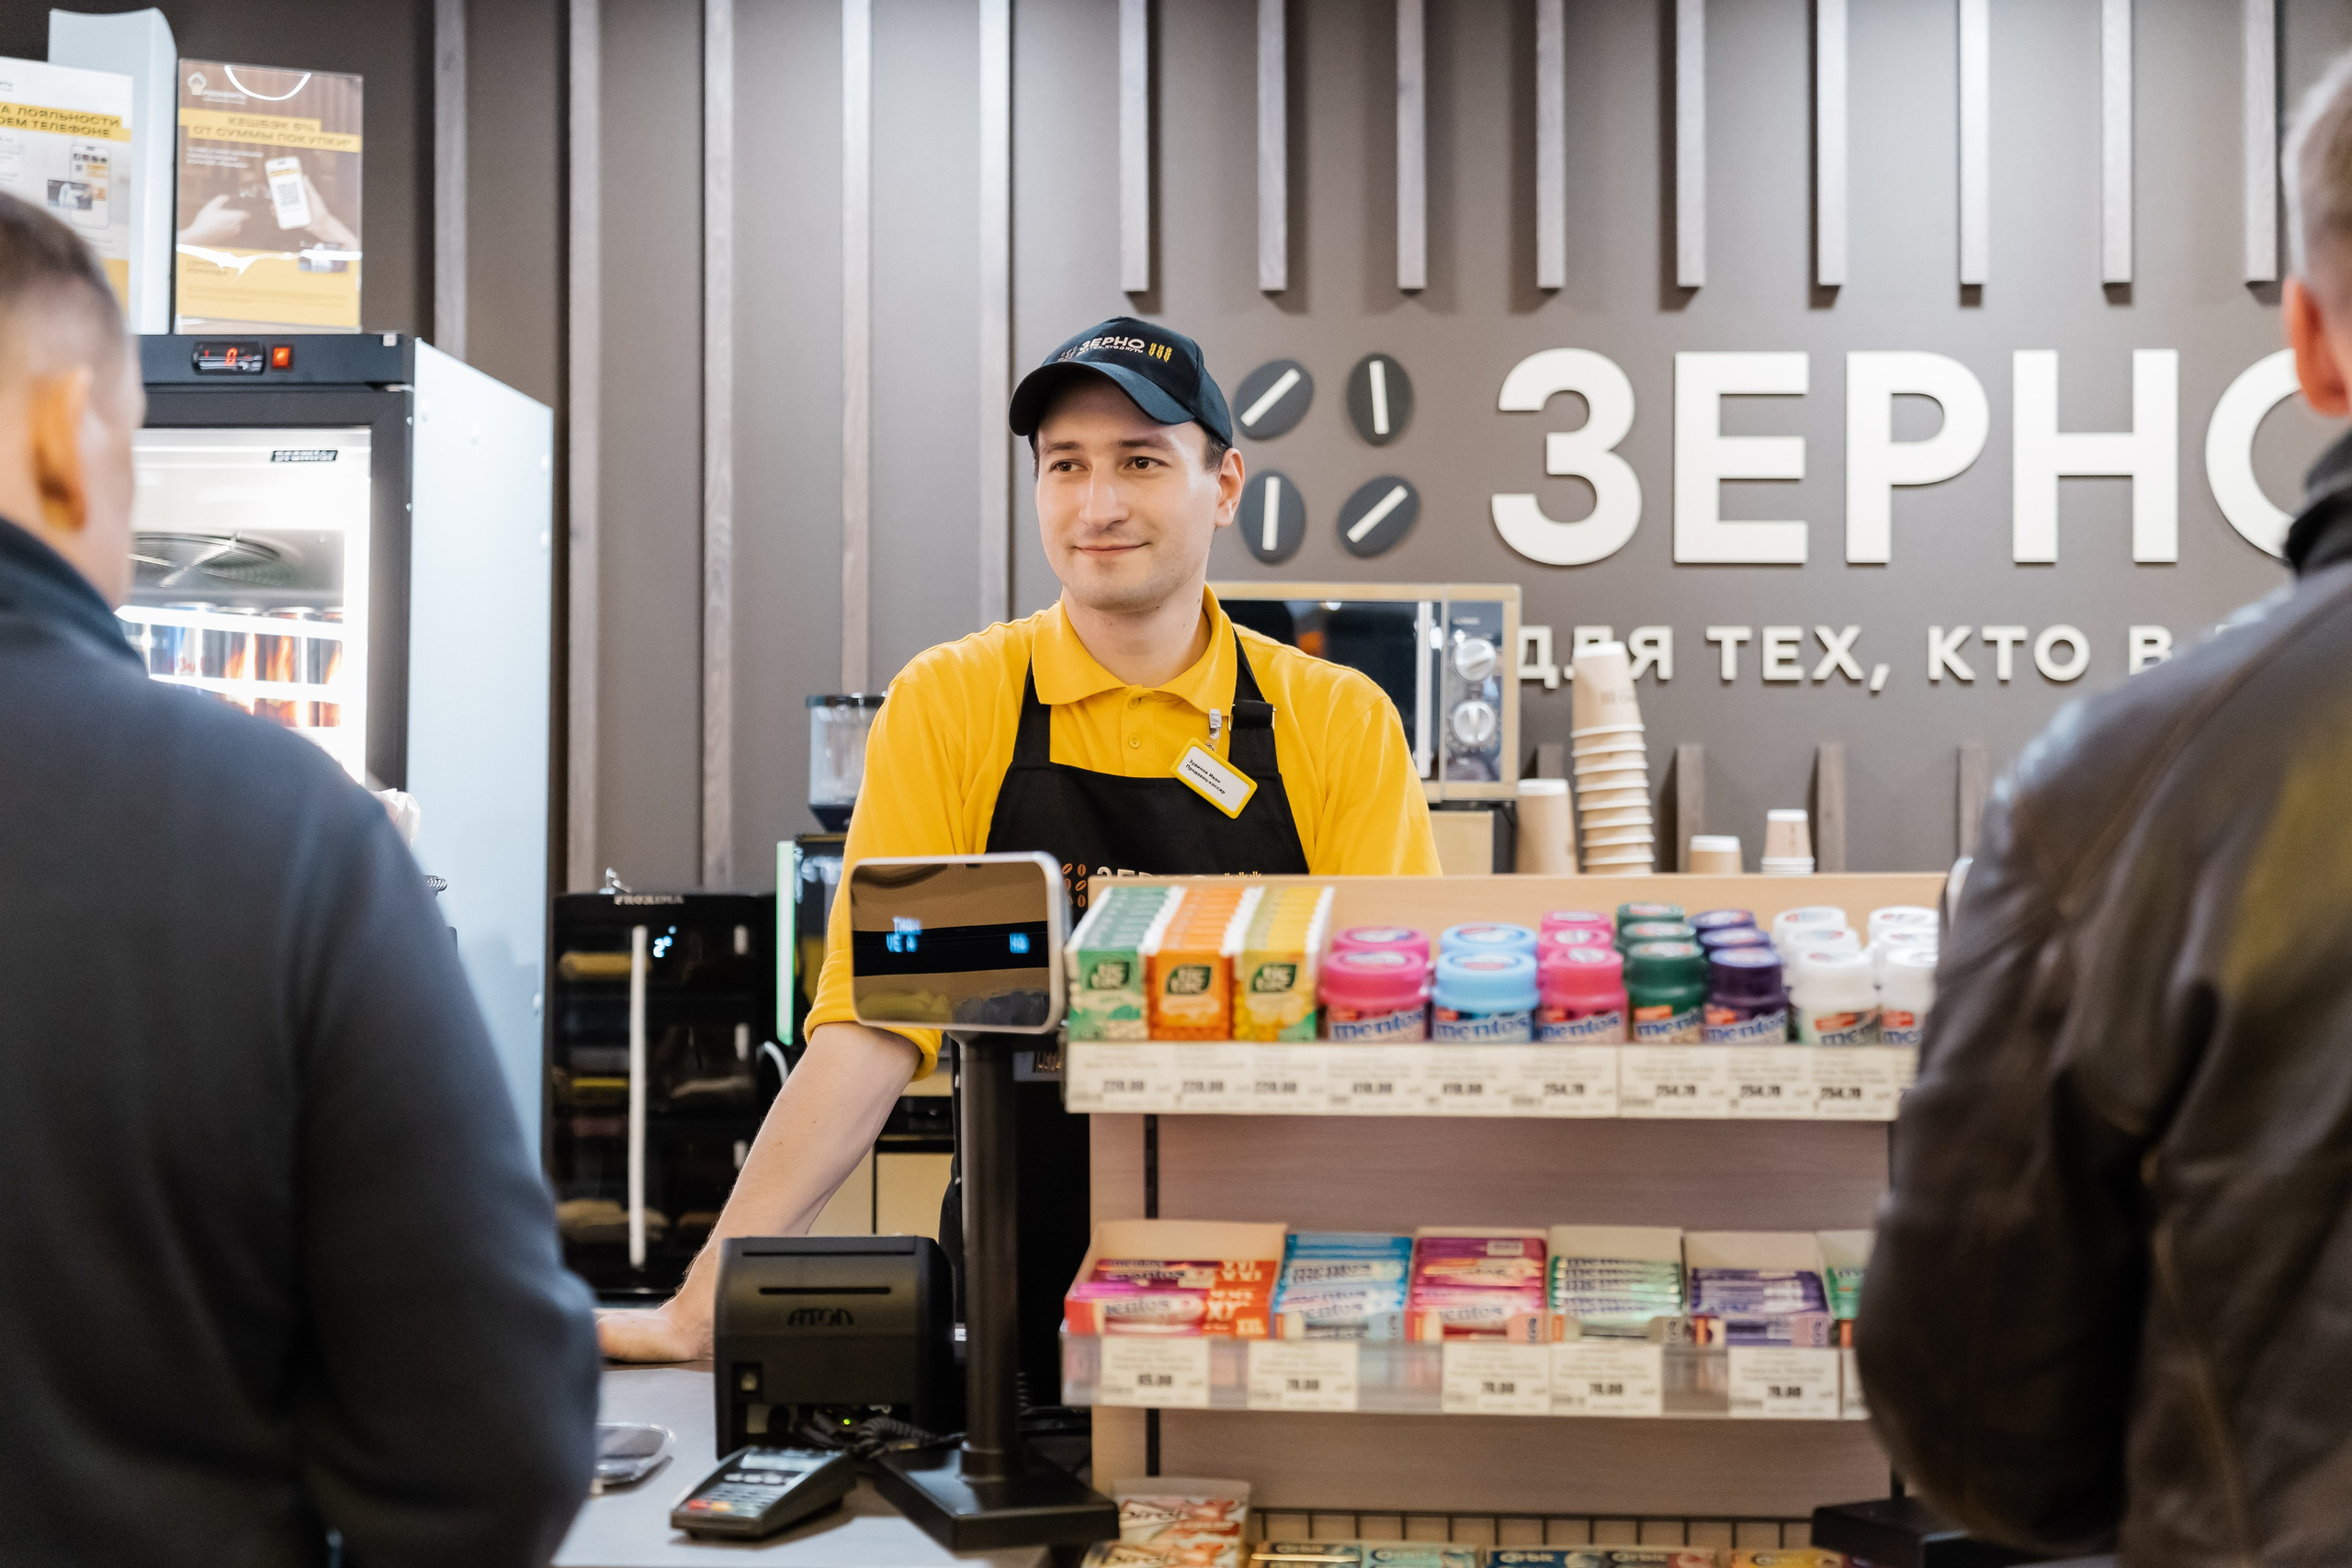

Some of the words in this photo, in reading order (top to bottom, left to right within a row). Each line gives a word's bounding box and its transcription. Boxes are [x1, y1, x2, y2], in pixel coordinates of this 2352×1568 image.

[18, 107, 119, 128] ЛОЯЛЬНОСТИ
[32, 120, 110, 137] ТЕЛЕФОНЕ
[193, 125, 211, 136] ОТ
[216, 128, 274, 141] СУММЫ
[1080, 336, 1145, 353] ЗЕРНО
[1706, 625, 1891, 693] ТЕХ,
[1928, 625, 2090, 682] КТО
[2129, 625, 2174, 675] В
[1333, 1012, 1423, 1041] mentos
[1435, 1014, 1527, 1040] mentos
[1540, 1015, 1619, 1038] mentos
[1105, 1300, 1170, 1316] entos
[1305, 1303, 1363, 1320] entos
[1439, 1306, 1503, 1324] entos
